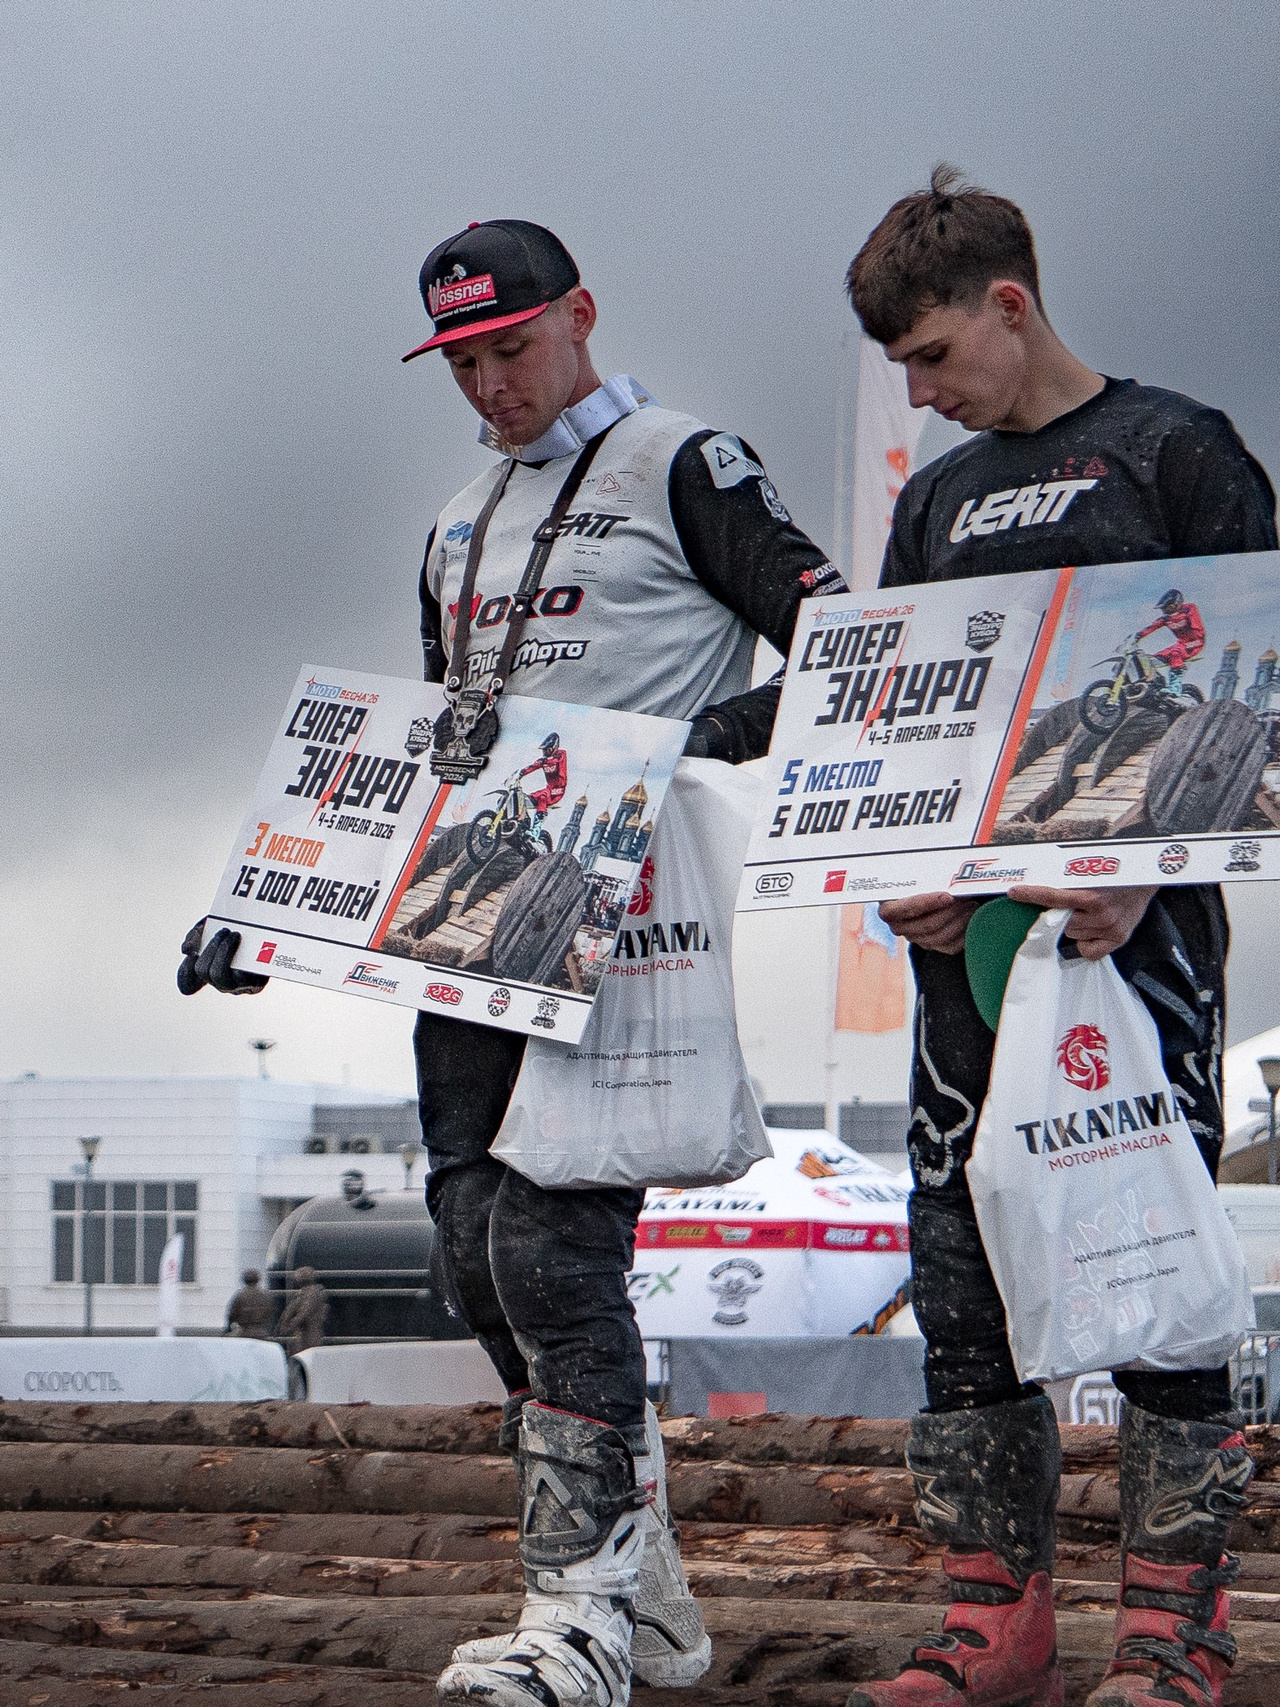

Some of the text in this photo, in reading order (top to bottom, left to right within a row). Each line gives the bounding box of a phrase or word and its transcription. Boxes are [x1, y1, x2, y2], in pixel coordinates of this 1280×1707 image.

[949, 479, 1098, 544] LEATT
[820, 610, 859, 625] МОТО
[798, 621, 905, 672] СУПЕР
[310, 684, 339, 699] МОТО
[814, 657, 994, 728] ЭНДУРО
[284, 698, 369, 745] СУПЕР
[868, 721, 977, 746] 4-5 АПРЕЛЯ 2026
[284, 745, 421, 815] ЭНДУРО
[778, 758, 884, 796] 5 МЕСТО
[768, 779, 963, 838] 5 000 РУБЛЕЙ
[318, 812, 397, 840] 4-5 АПРЕЛЯ 2026
[245, 822, 326, 868] 3 МЕСТО
[955, 864, 1028, 881] ДВИЖЕНИЕ
[1067, 858, 1119, 875] RRG
[231, 864, 381, 922] 15 000 РУБЛЕЙ
[760, 876, 790, 889] БТС
[847, 880, 917, 892] ПЕРЕВОЗОЧНАЯ
[849, 877, 878, 886] НОВАЯ
[613, 921, 712, 960] AYAM
[272, 960, 322, 976] ПЕРЕВОЗОЧНАЯ
[275, 953, 297, 964] НОВАЯ
[606, 963, 649, 977] ОРНЫЕ
[349, 965, 400, 990] ДВИЖЕНИЕ
[425, 983, 463, 1006] RRG
[566, 1052, 621, 1061] АДАПТИВНАЯ
[1120, 1132, 1173, 1154] МАСЛА
[643, 1199, 766, 1212] KAYAMA
[1083, 1388, 1127, 1425] БТ
